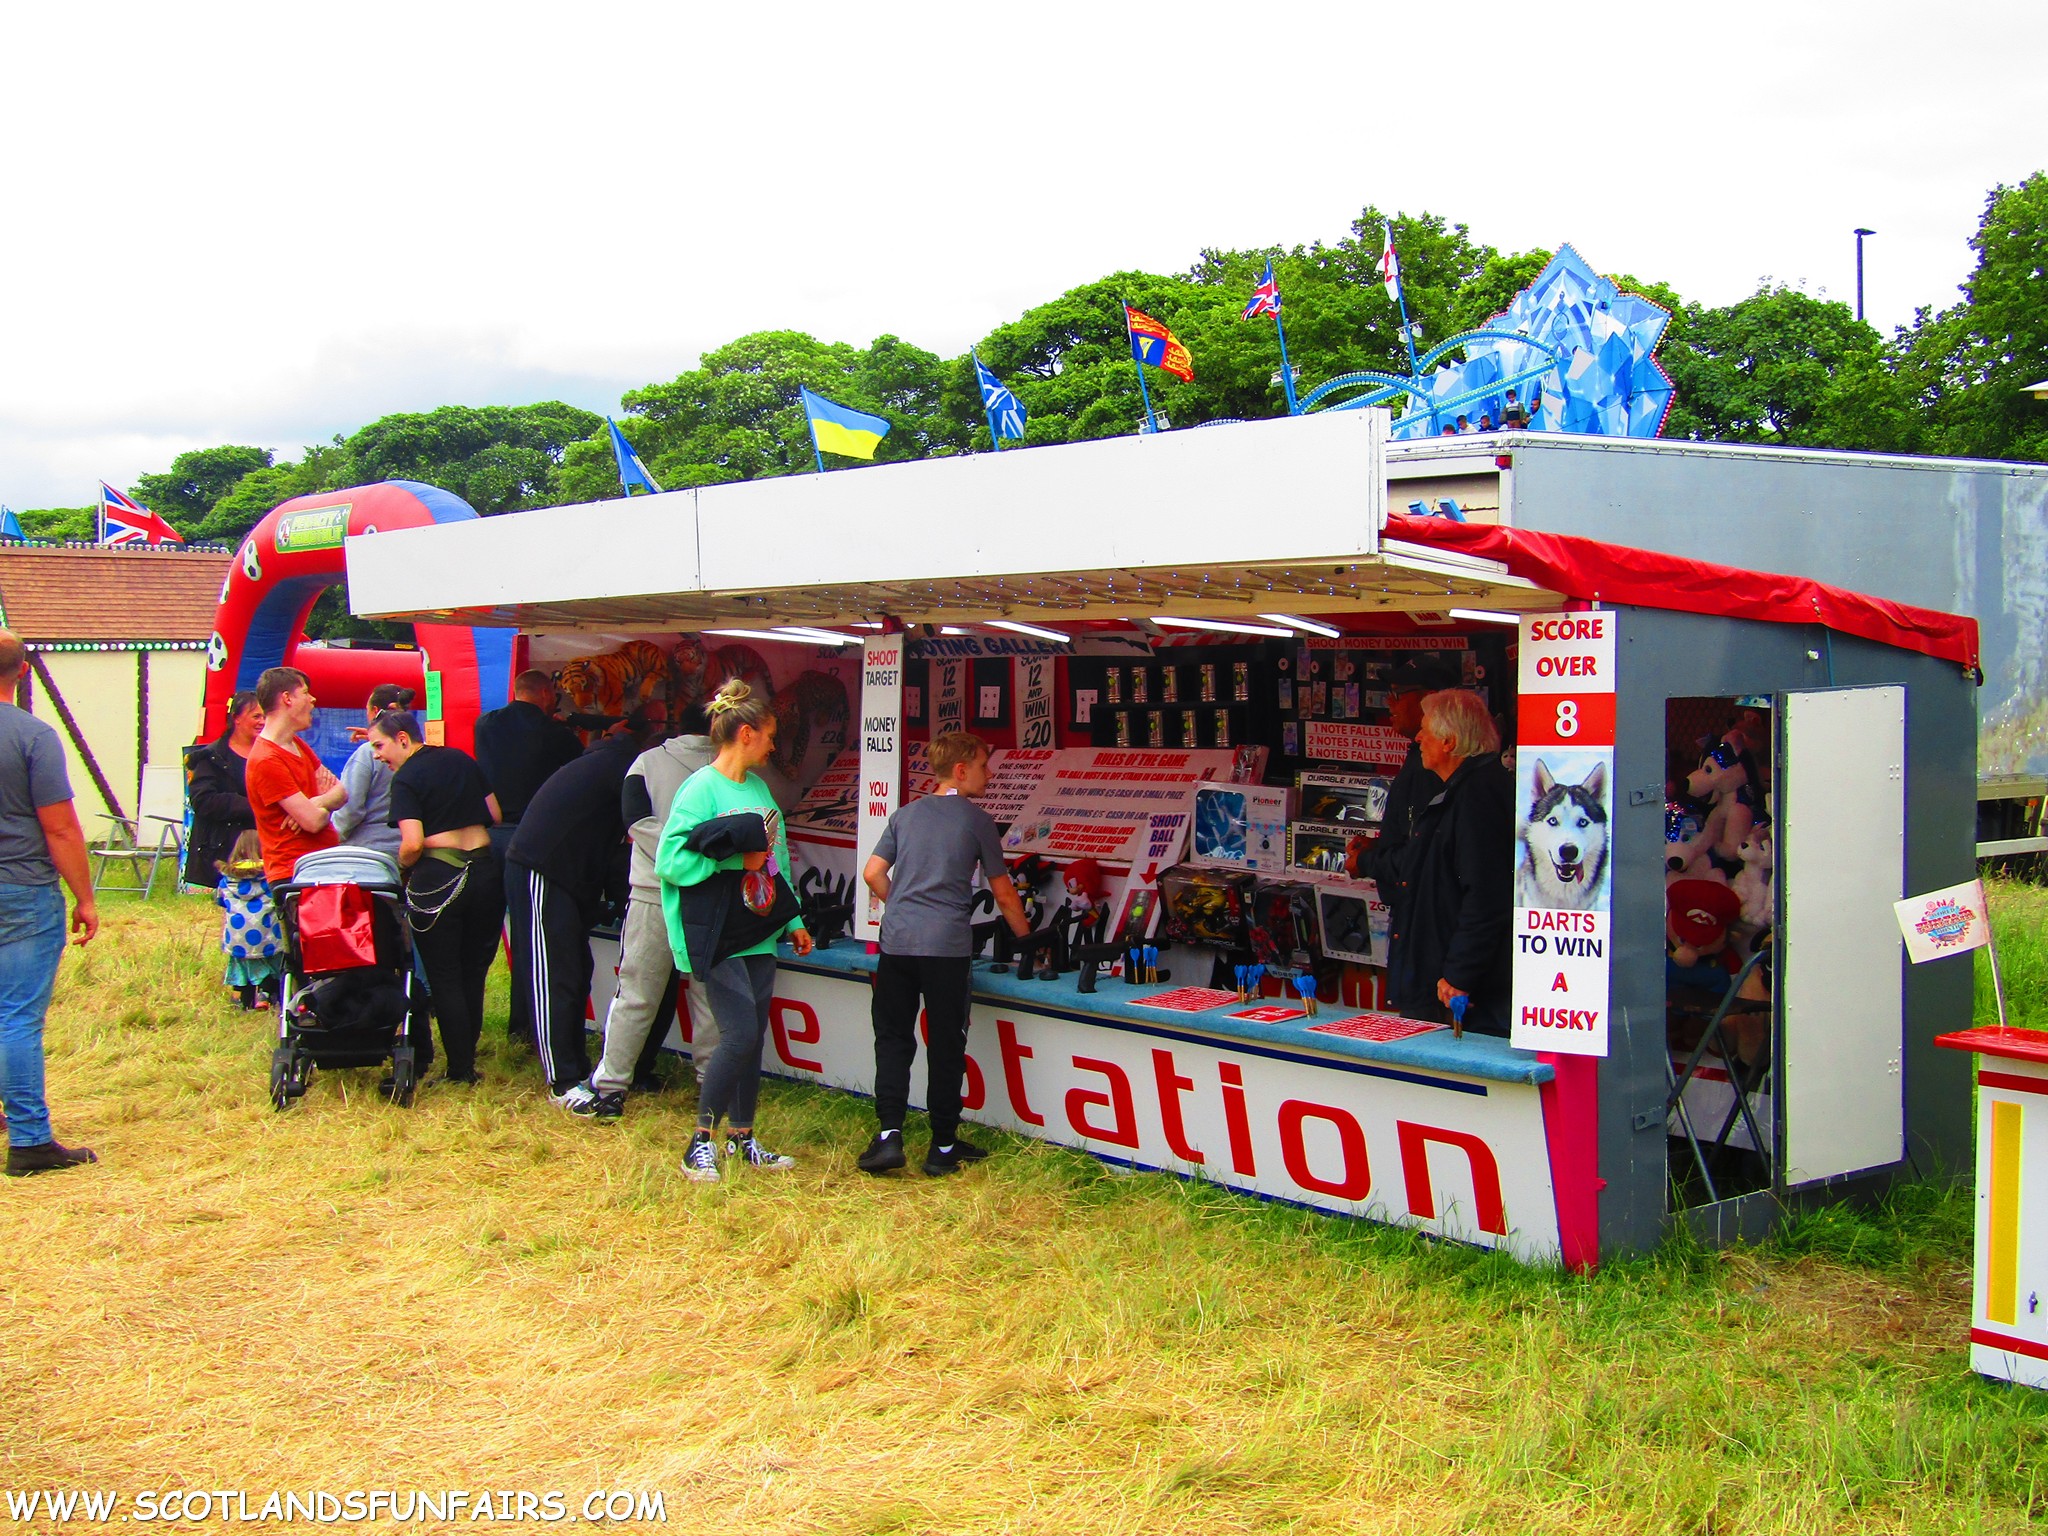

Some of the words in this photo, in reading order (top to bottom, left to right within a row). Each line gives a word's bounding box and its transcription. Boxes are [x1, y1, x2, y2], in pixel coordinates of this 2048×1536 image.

[1530, 619, 1604, 642] SCORE
[1307, 638, 1342, 648] SHOOT
[1344, 638, 1381, 648] MONEY
[1385, 638, 1420, 648] DOWN
[1425, 638, 1437, 648] TO
[1441, 638, 1465, 648] WIN
[867, 650, 898, 666] SHOOT
[1536, 654, 1597, 678] OVER
[865, 670, 899, 686] TARGET
[943, 665, 955, 687] 12
[1029, 664, 1042, 687] 12
[942, 688, 956, 697] AND
[1027, 687, 1042, 699] AND
[938, 700, 960, 718] WIN
[1024, 699, 1048, 717] WIN
[864, 717, 896, 732] MONEY
[1554, 701, 1579, 738] 8
[1022, 720, 1051, 748] £20
[1313, 724, 1319, 733] 1
[1320, 724, 1344, 735] NOTE
[1345, 725, 1380, 737] FALLS
[867, 737, 893, 752] FALLS
[1308, 735, 1315, 745] 2
[1316, 735, 1349, 747] NOTES
[1351, 737, 1382, 749] FALLS
[1003, 750, 1054, 761] RULES
[1093, 752, 1124, 766] RULES
[1124, 753, 1138, 766] OF
[1138, 754, 1159, 767] THE
[1158, 754, 1190, 767] GAME
[1307, 747, 1314, 757] 3
[1316, 747, 1348, 759] NOTES
[1350, 749, 1381, 761] FALLS
[821, 773, 850, 783] SCORE
[996, 772, 1031, 780] BULLSEYE
[1056, 770, 1068, 779] THE
[1068, 770, 1083, 779] BALL
[1083, 771, 1101, 780] MUST
[1110, 772, 1123, 781] OFF
[1122, 772, 1142, 781] STAND
[1149, 773, 1165, 782] CAN
[1164, 773, 1180, 783] LIKE
[811, 788, 840, 798] SCORE
[869, 781, 888, 798] YOU
[1061, 788, 1076, 796] BALL
[1075, 788, 1088, 796] OFF
[1087, 788, 1106, 797] WINS
[1114, 789, 1133, 798] CASH
[1143, 790, 1165, 799] SMALL
[1165, 791, 1186, 800] PRIZE
[1252, 796, 1282, 806] Pioneer
[868, 802, 887, 817] WIN
[1043, 808, 1064, 816] BALLS
[1062, 808, 1075, 816] OFF
[1074, 809, 1093, 817] WINS
[1105, 810, 1125, 819] CASH
[1123, 811, 1135, 820] OR
[824, 817, 848, 828] WIN
[1150, 815, 1186, 828] SHOOT
[1053, 822, 1085, 832] STRICTLY
[1082, 824, 1093, 833] NO
[1091, 824, 1119, 835] LEANING
[1117, 826, 1136, 836] OVER
[1150, 830, 1175, 842] BALL
[1342, 829, 1368, 837] KINGS
[1077, 834, 1108, 844] COUNTER
[1075, 843, 1085, 851] TO
[1096, 845, 1116, 854] GAME
[1148, 844, 1169, 858] OFF
[1527, 910, 1596, 932] DARTS
[1518, 934, 1549, 957] TO
[1554, 936, 1603, 958] WIN
[1551, 972, 1569, 994] A
[1521, 1006, 1598, 1032] HUSKY
